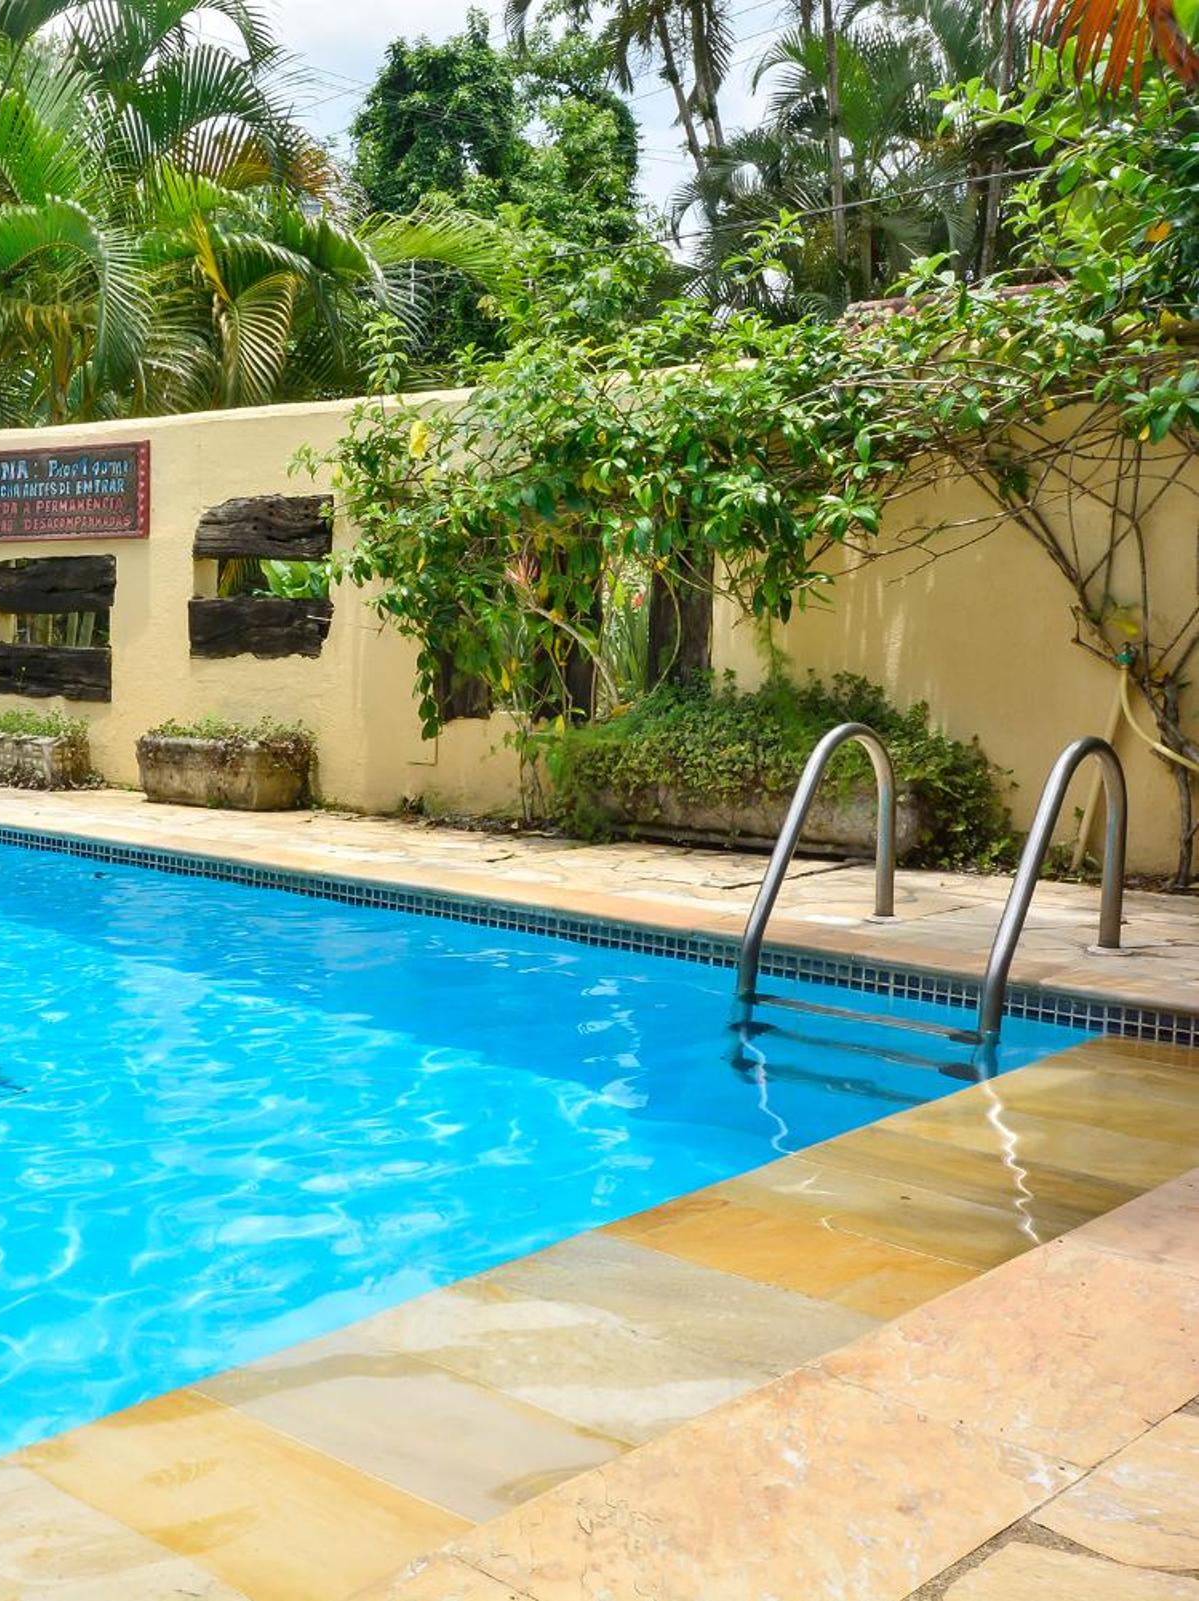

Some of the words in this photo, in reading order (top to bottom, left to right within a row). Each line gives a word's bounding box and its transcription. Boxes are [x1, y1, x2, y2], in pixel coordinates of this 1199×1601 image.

[23, 482, 57, 498] ANTES
[76, 479, 125, 496] ENTRAR
[23, 501, 31, 514] A
